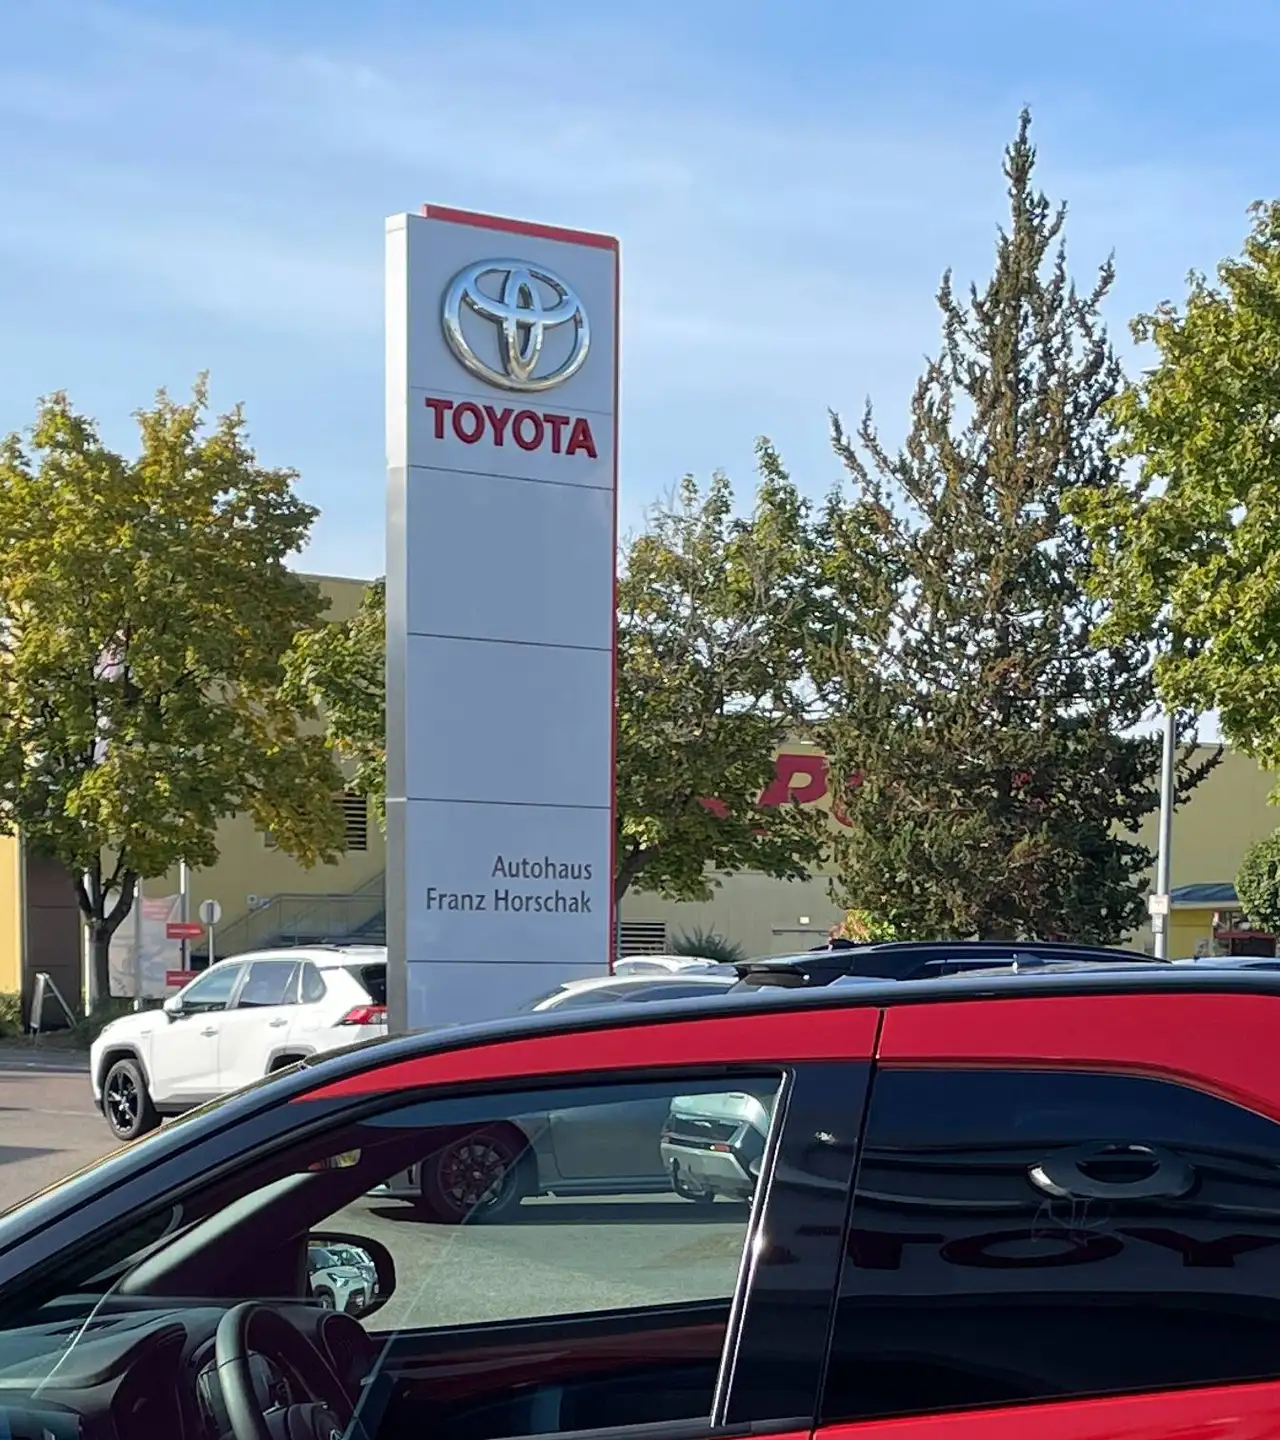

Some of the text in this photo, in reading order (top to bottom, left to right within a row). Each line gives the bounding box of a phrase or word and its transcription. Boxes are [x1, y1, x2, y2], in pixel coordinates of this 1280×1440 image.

[425, 397, 597, 458] TOYOTA
[491, 855, 593, 880] Autohaus
[426, 887, 592, 913] Franz Horschak
